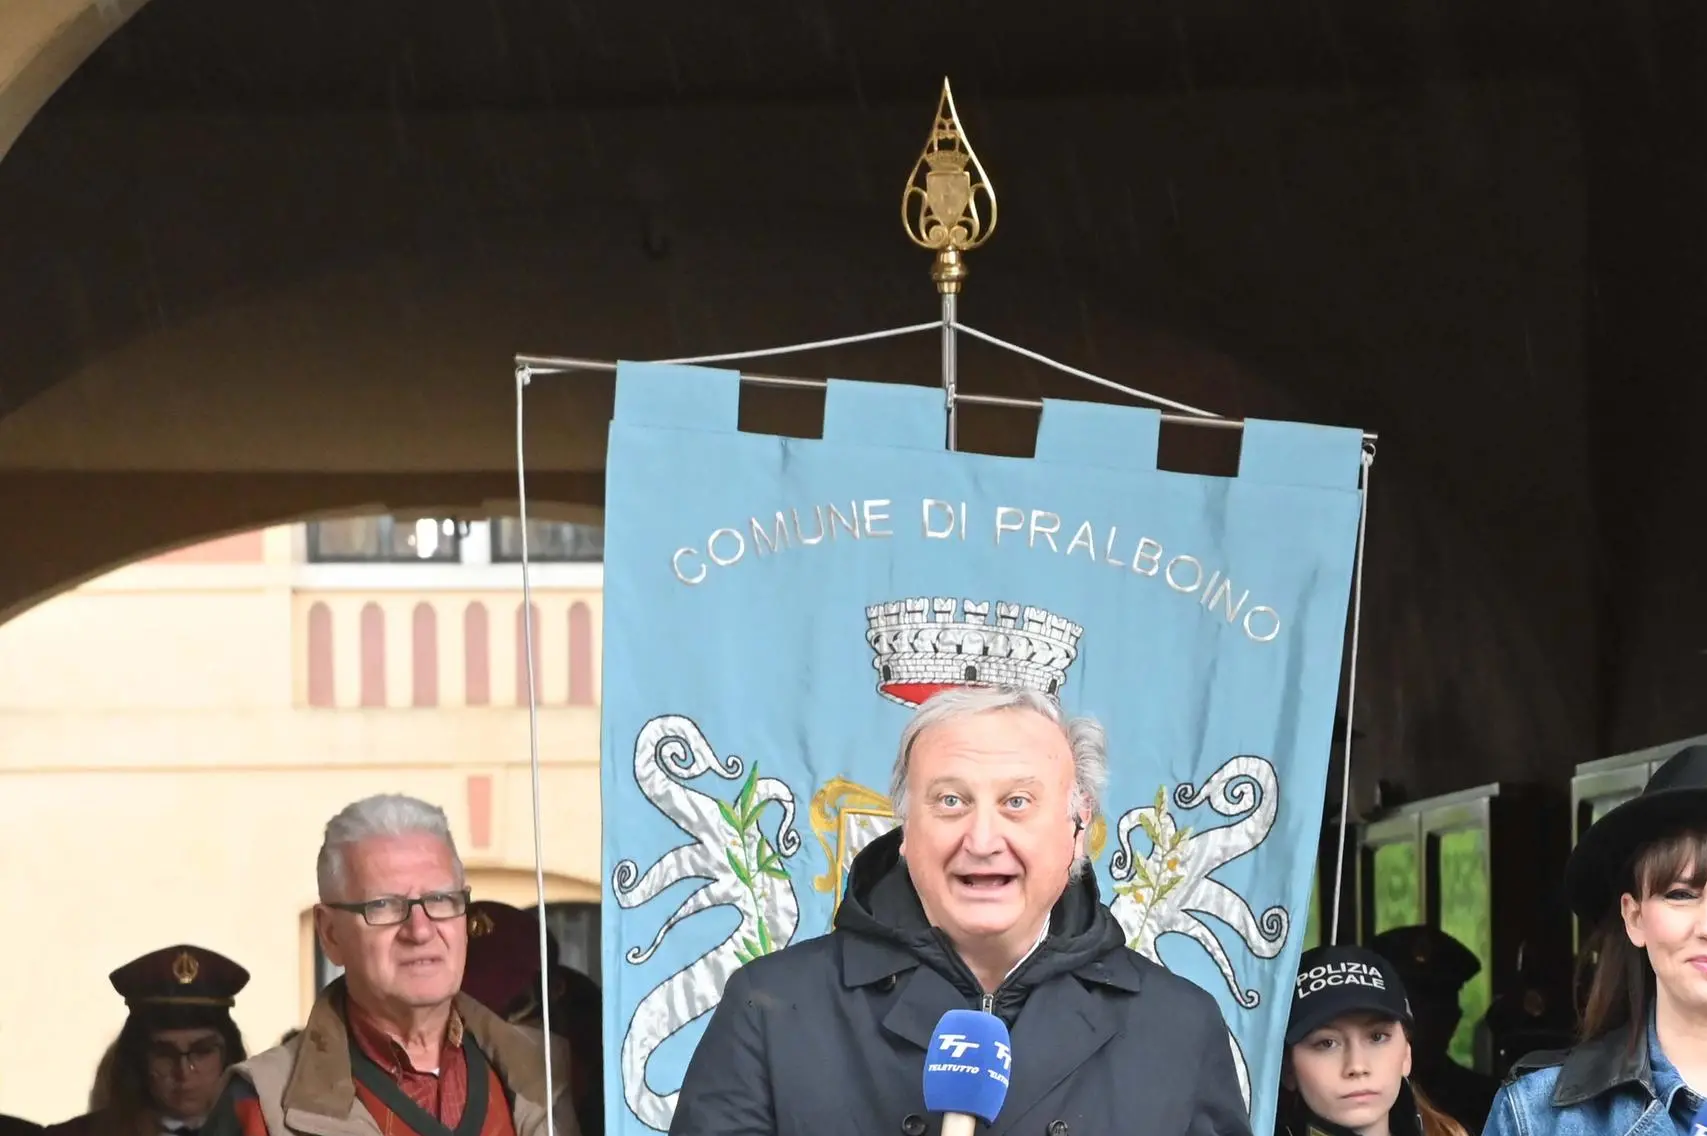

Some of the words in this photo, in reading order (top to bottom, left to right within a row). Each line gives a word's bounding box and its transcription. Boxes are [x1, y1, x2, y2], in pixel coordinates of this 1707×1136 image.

[672, 498, 893, 585] COMUNE
[922, 498, 967, 541] DI
[995, 506, 1281, 642] PRALBOINO
[1296, 962, 1383, 987] POLIZIA
[1298, 974, 1386, 999] LOCALE
[928, 1064, 980, 1074] TELETUTTO
